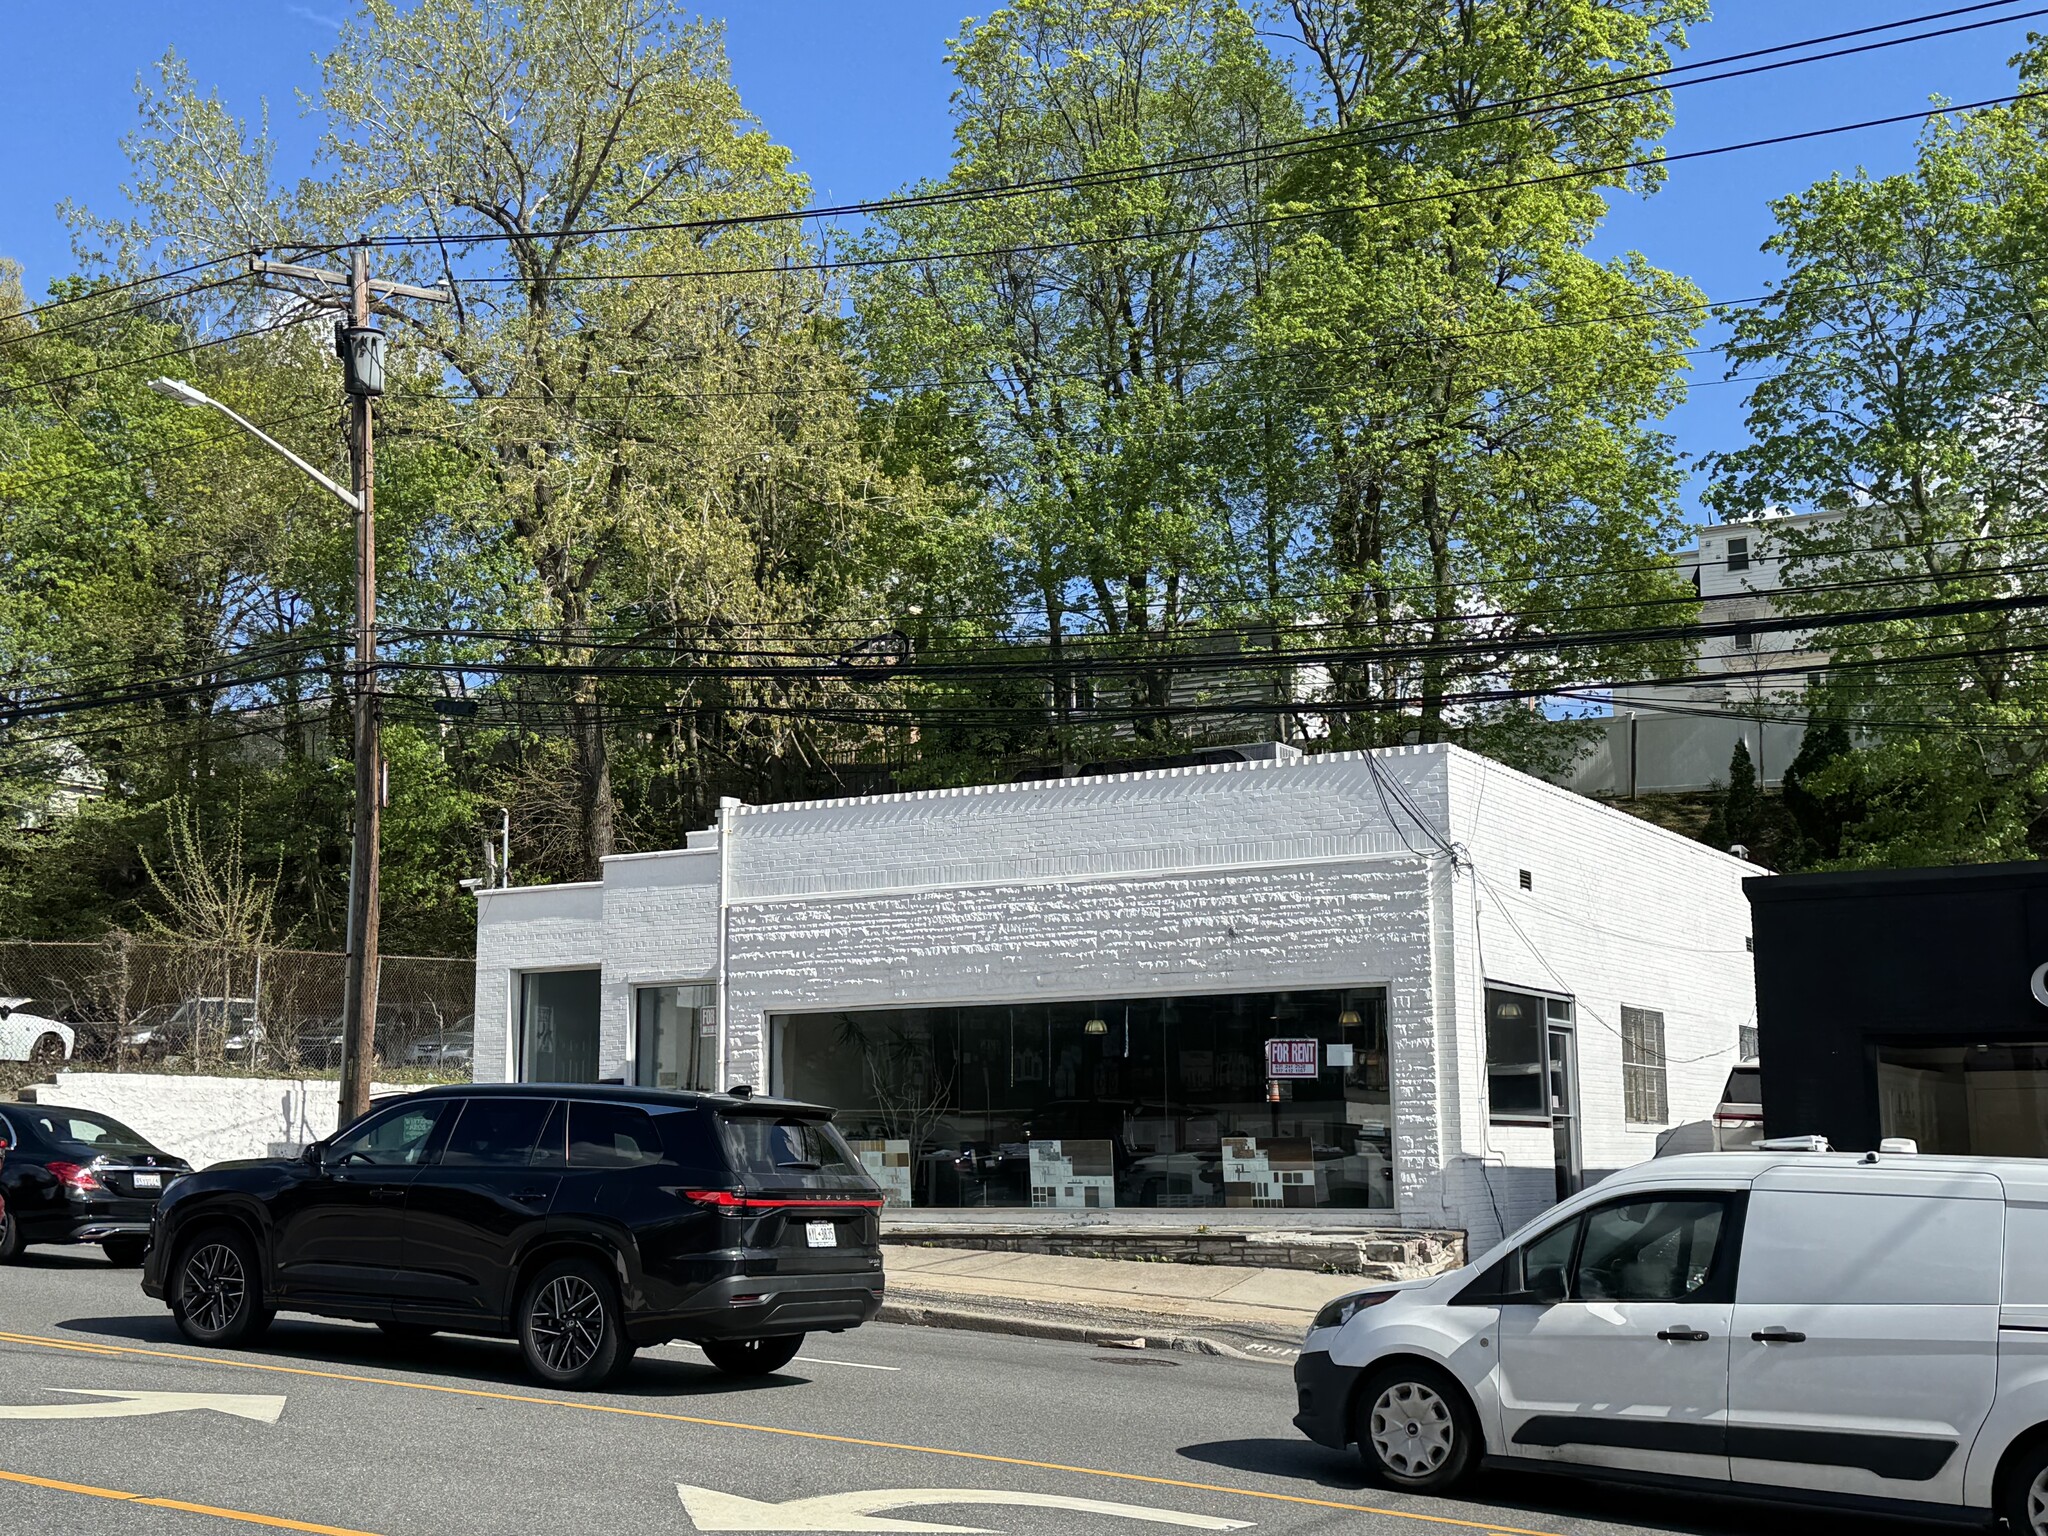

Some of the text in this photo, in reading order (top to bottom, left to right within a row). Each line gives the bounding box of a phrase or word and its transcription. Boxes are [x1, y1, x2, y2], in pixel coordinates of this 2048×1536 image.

[702, 1009, 715, 1025] FOR
[1272, 1043, 1315, 1062] FOR RENT
